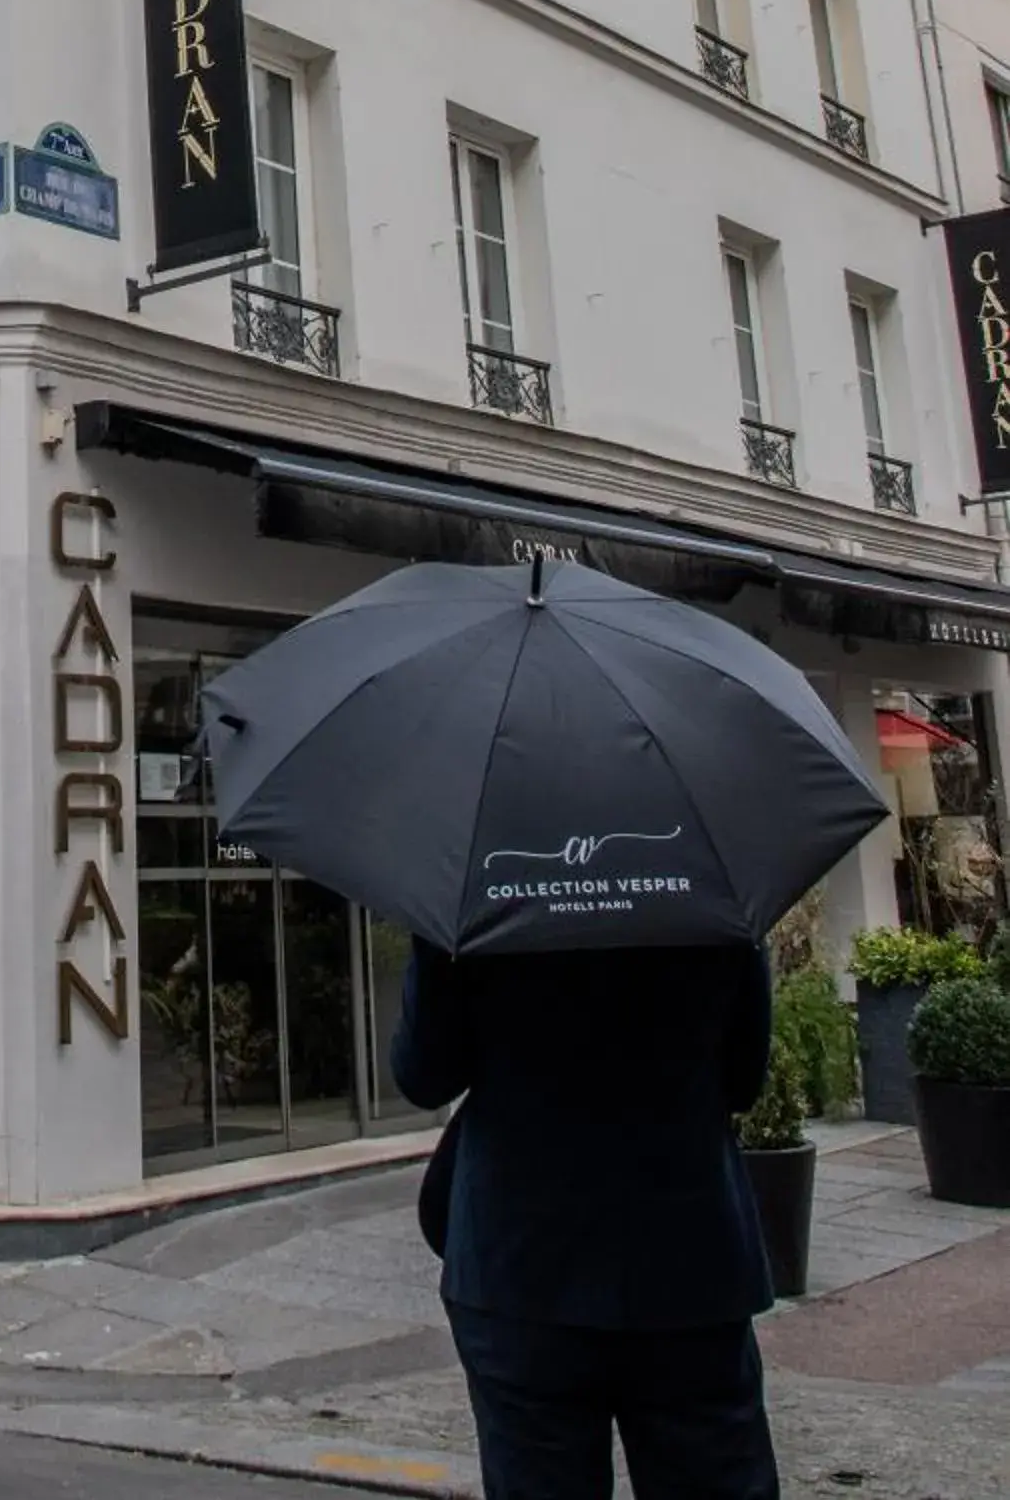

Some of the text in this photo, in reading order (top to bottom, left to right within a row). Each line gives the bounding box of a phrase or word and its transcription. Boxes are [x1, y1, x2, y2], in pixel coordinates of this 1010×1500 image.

[53, 491, 128, 1045] CADRAN
[217, 842, 256, 861] hôte
[487, 877, 690, 899] COLLECTION VESPER
[549, 900, 633, 913] HOTELS PARIS
